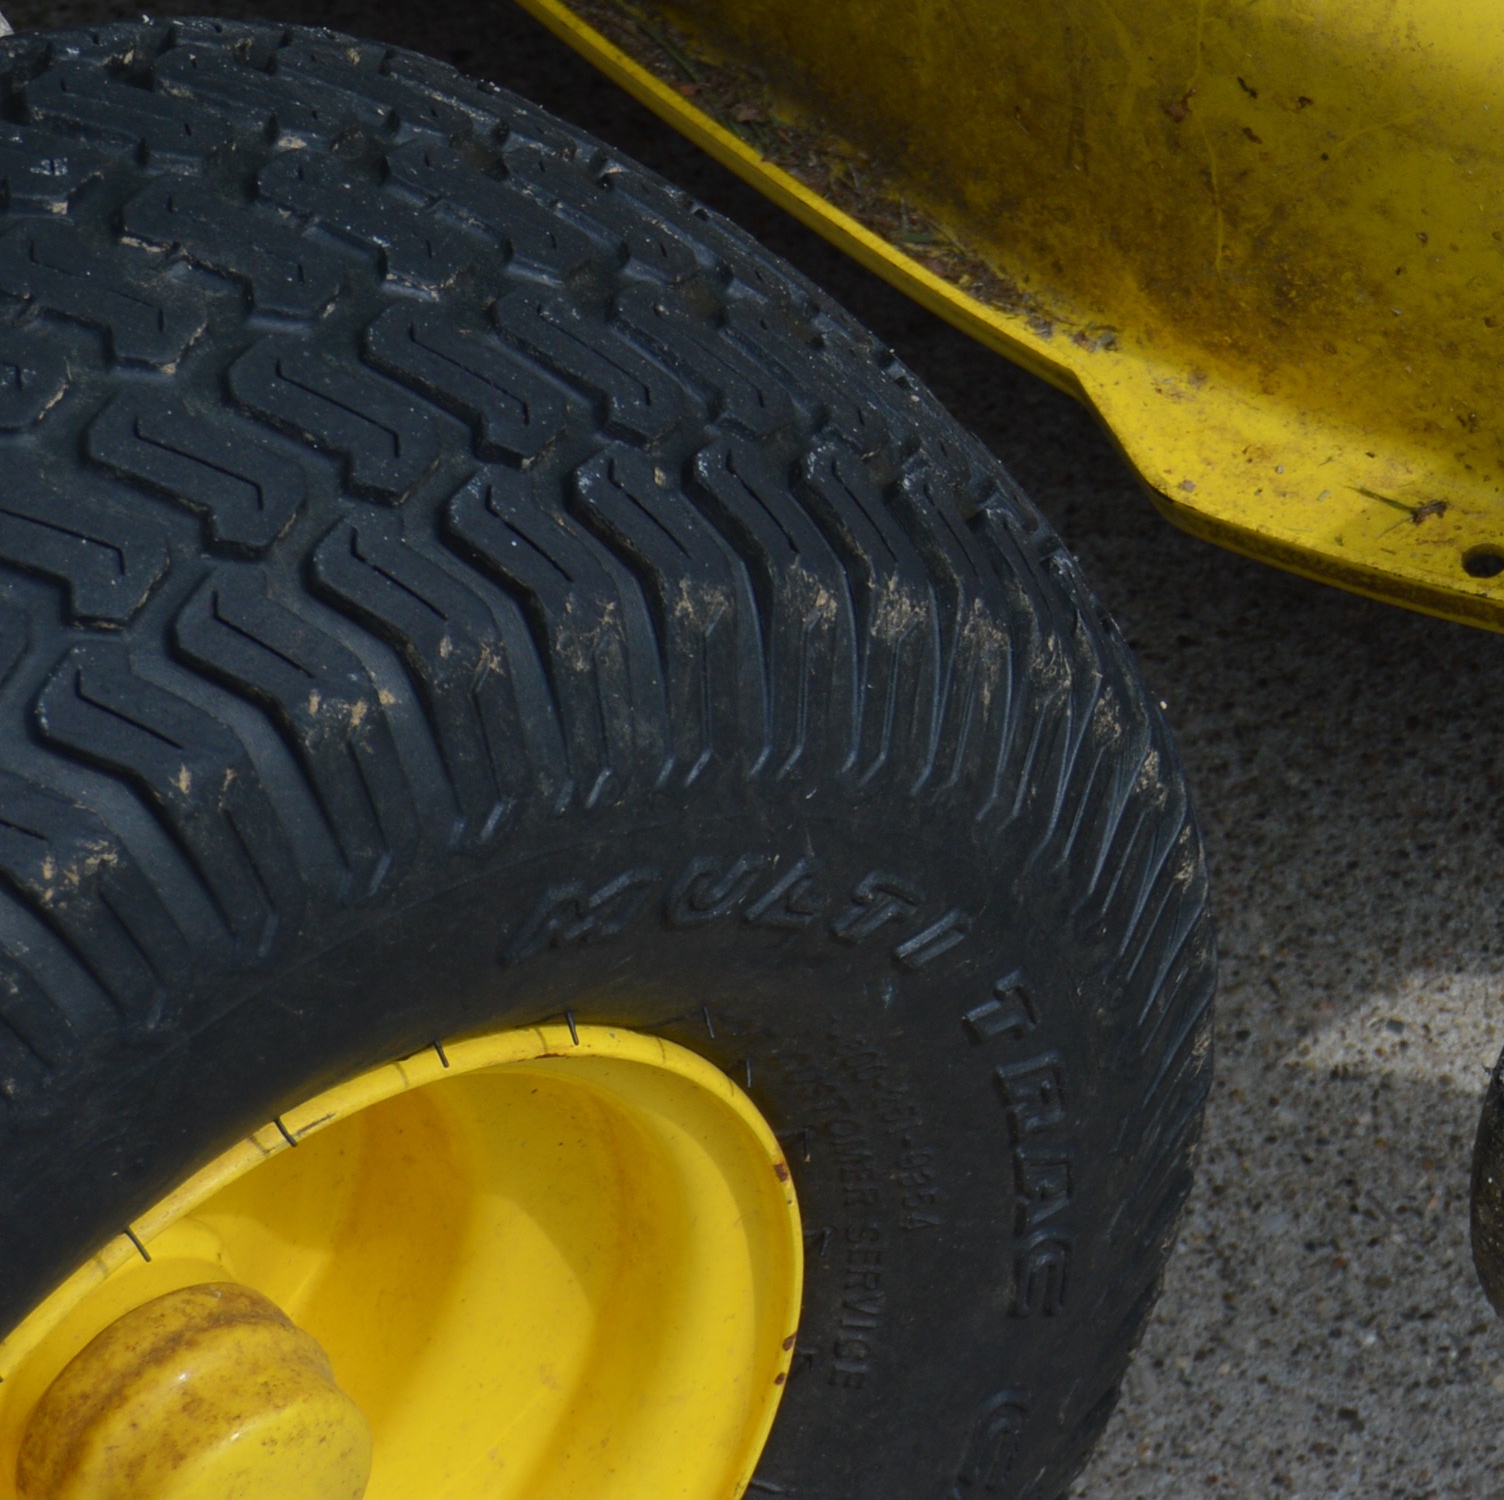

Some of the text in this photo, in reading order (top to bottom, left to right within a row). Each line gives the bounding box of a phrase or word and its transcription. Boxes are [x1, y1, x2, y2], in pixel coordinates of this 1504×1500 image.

[501, 853, 976, 971] MULTI
[959, 967, 1076, 1319] TRAC
[825, 1217, 886, 1392] SERVICE
